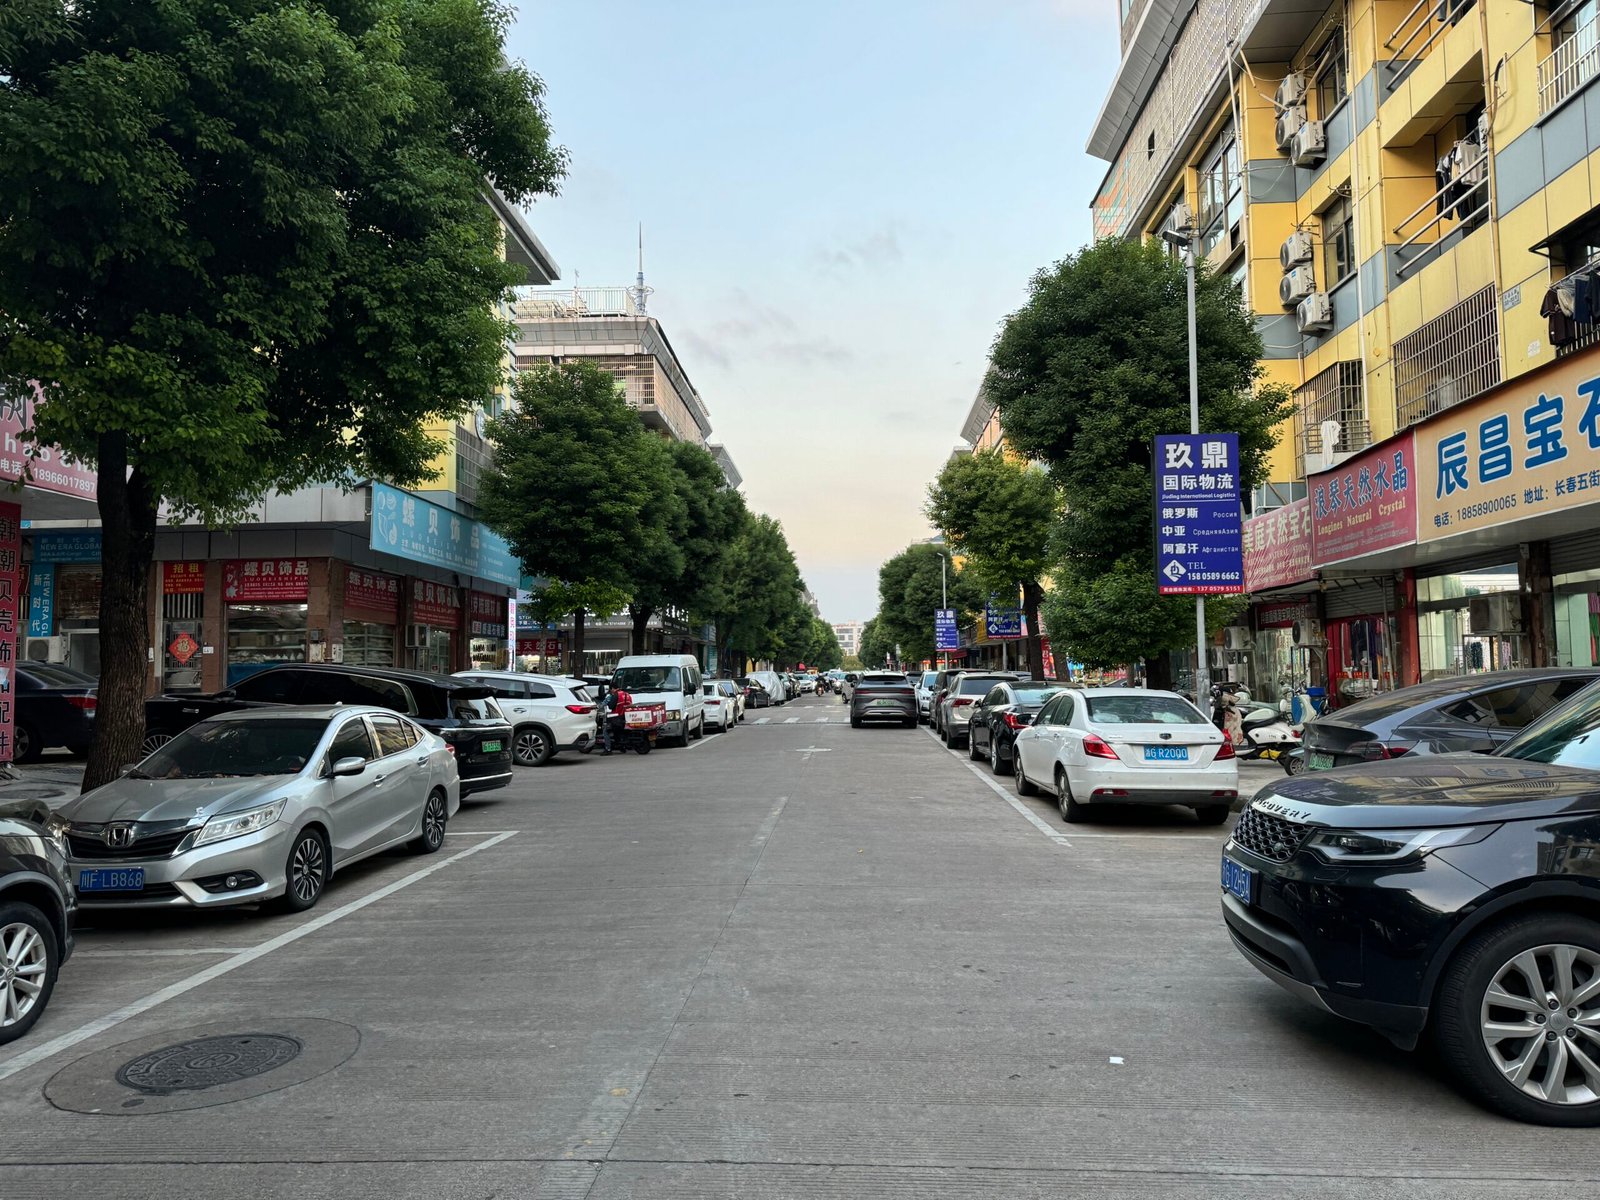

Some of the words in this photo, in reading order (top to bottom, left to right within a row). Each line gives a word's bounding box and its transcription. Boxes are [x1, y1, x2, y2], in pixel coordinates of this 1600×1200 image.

[1165, 441, 1229, 470] 玖鼎
[33, 467, 96, 493] 18966017897
[1163, 474, 1234, 491] 国际物流
[1315, 450, 1410, 522] 浪琴天然水晶
[1162, 507, 1198, 519] 俄罗斯
[1457, 493, 1518, 521] 18858900065
[1318, 519, 1344, 537] Longines
[1347, 508, 1373, 527] Natural
[1378, 496, 1407, 517] Crystal
[1162, 525, 1186, 537] 中亚
[1162, 543, 1199, 554] 阿富汗
[244, 561, 309, 576] 螺贝饰品
[1187, 562, 1206, 570] TEL
[1201, 572, 1221, 580] 0589
[1222, 572, 1240, 580] 6662
[42, 600, 50, 620] ERA
